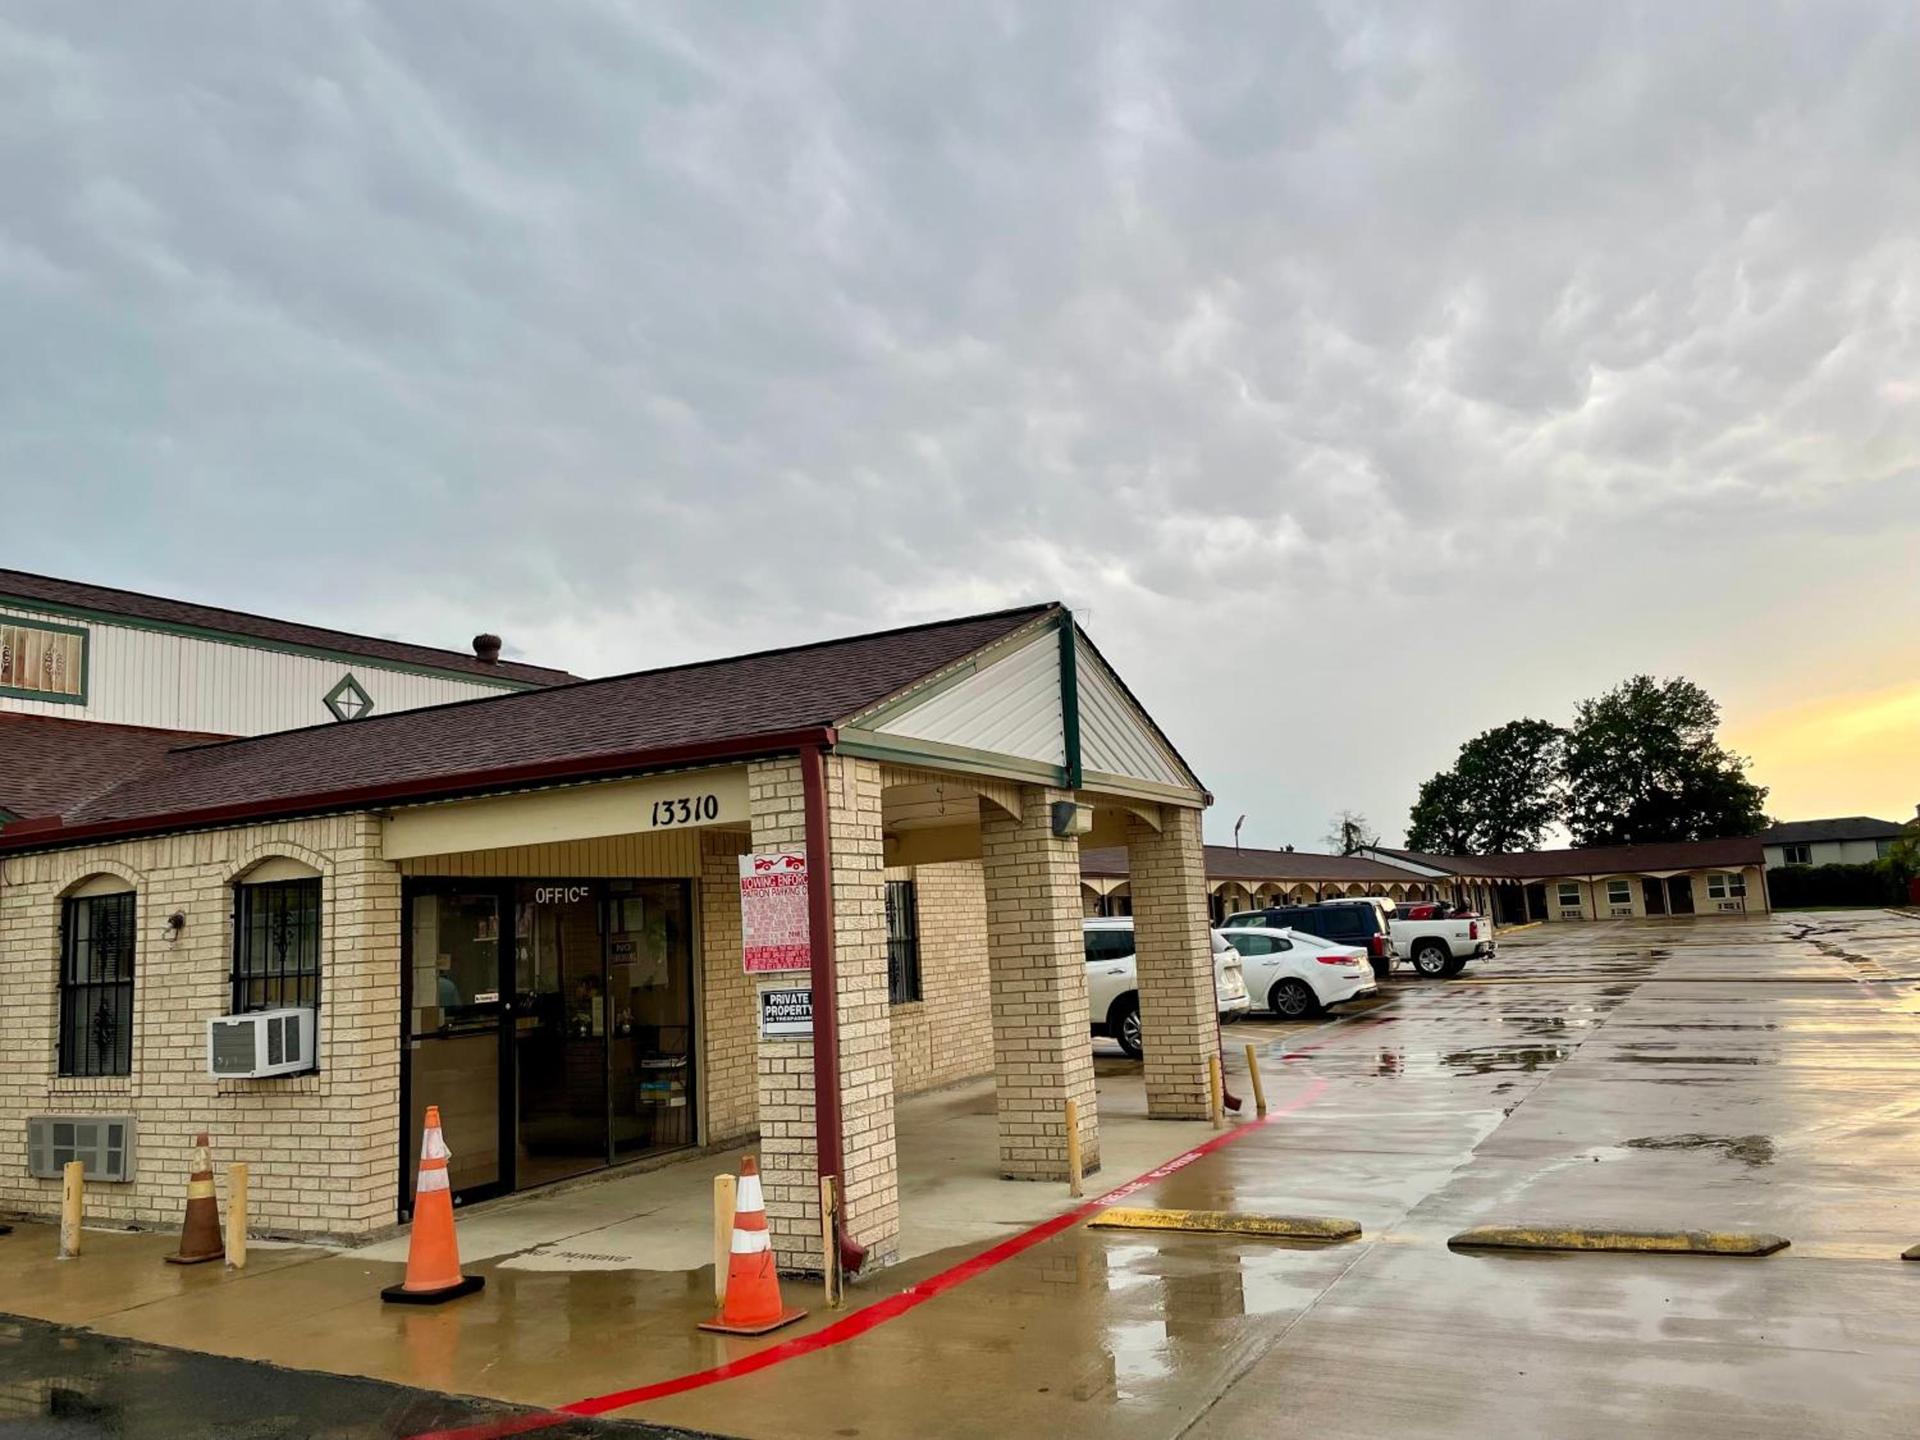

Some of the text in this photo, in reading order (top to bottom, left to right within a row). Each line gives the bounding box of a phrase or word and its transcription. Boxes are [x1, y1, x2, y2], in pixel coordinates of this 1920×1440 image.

[652, 794, 719, 827] 13310
[741, 873, 808, 889] TOWING ENFORC
[742, 888, 770, 898] PATRON
[770, 993, 809, 1005] PRIVATE
